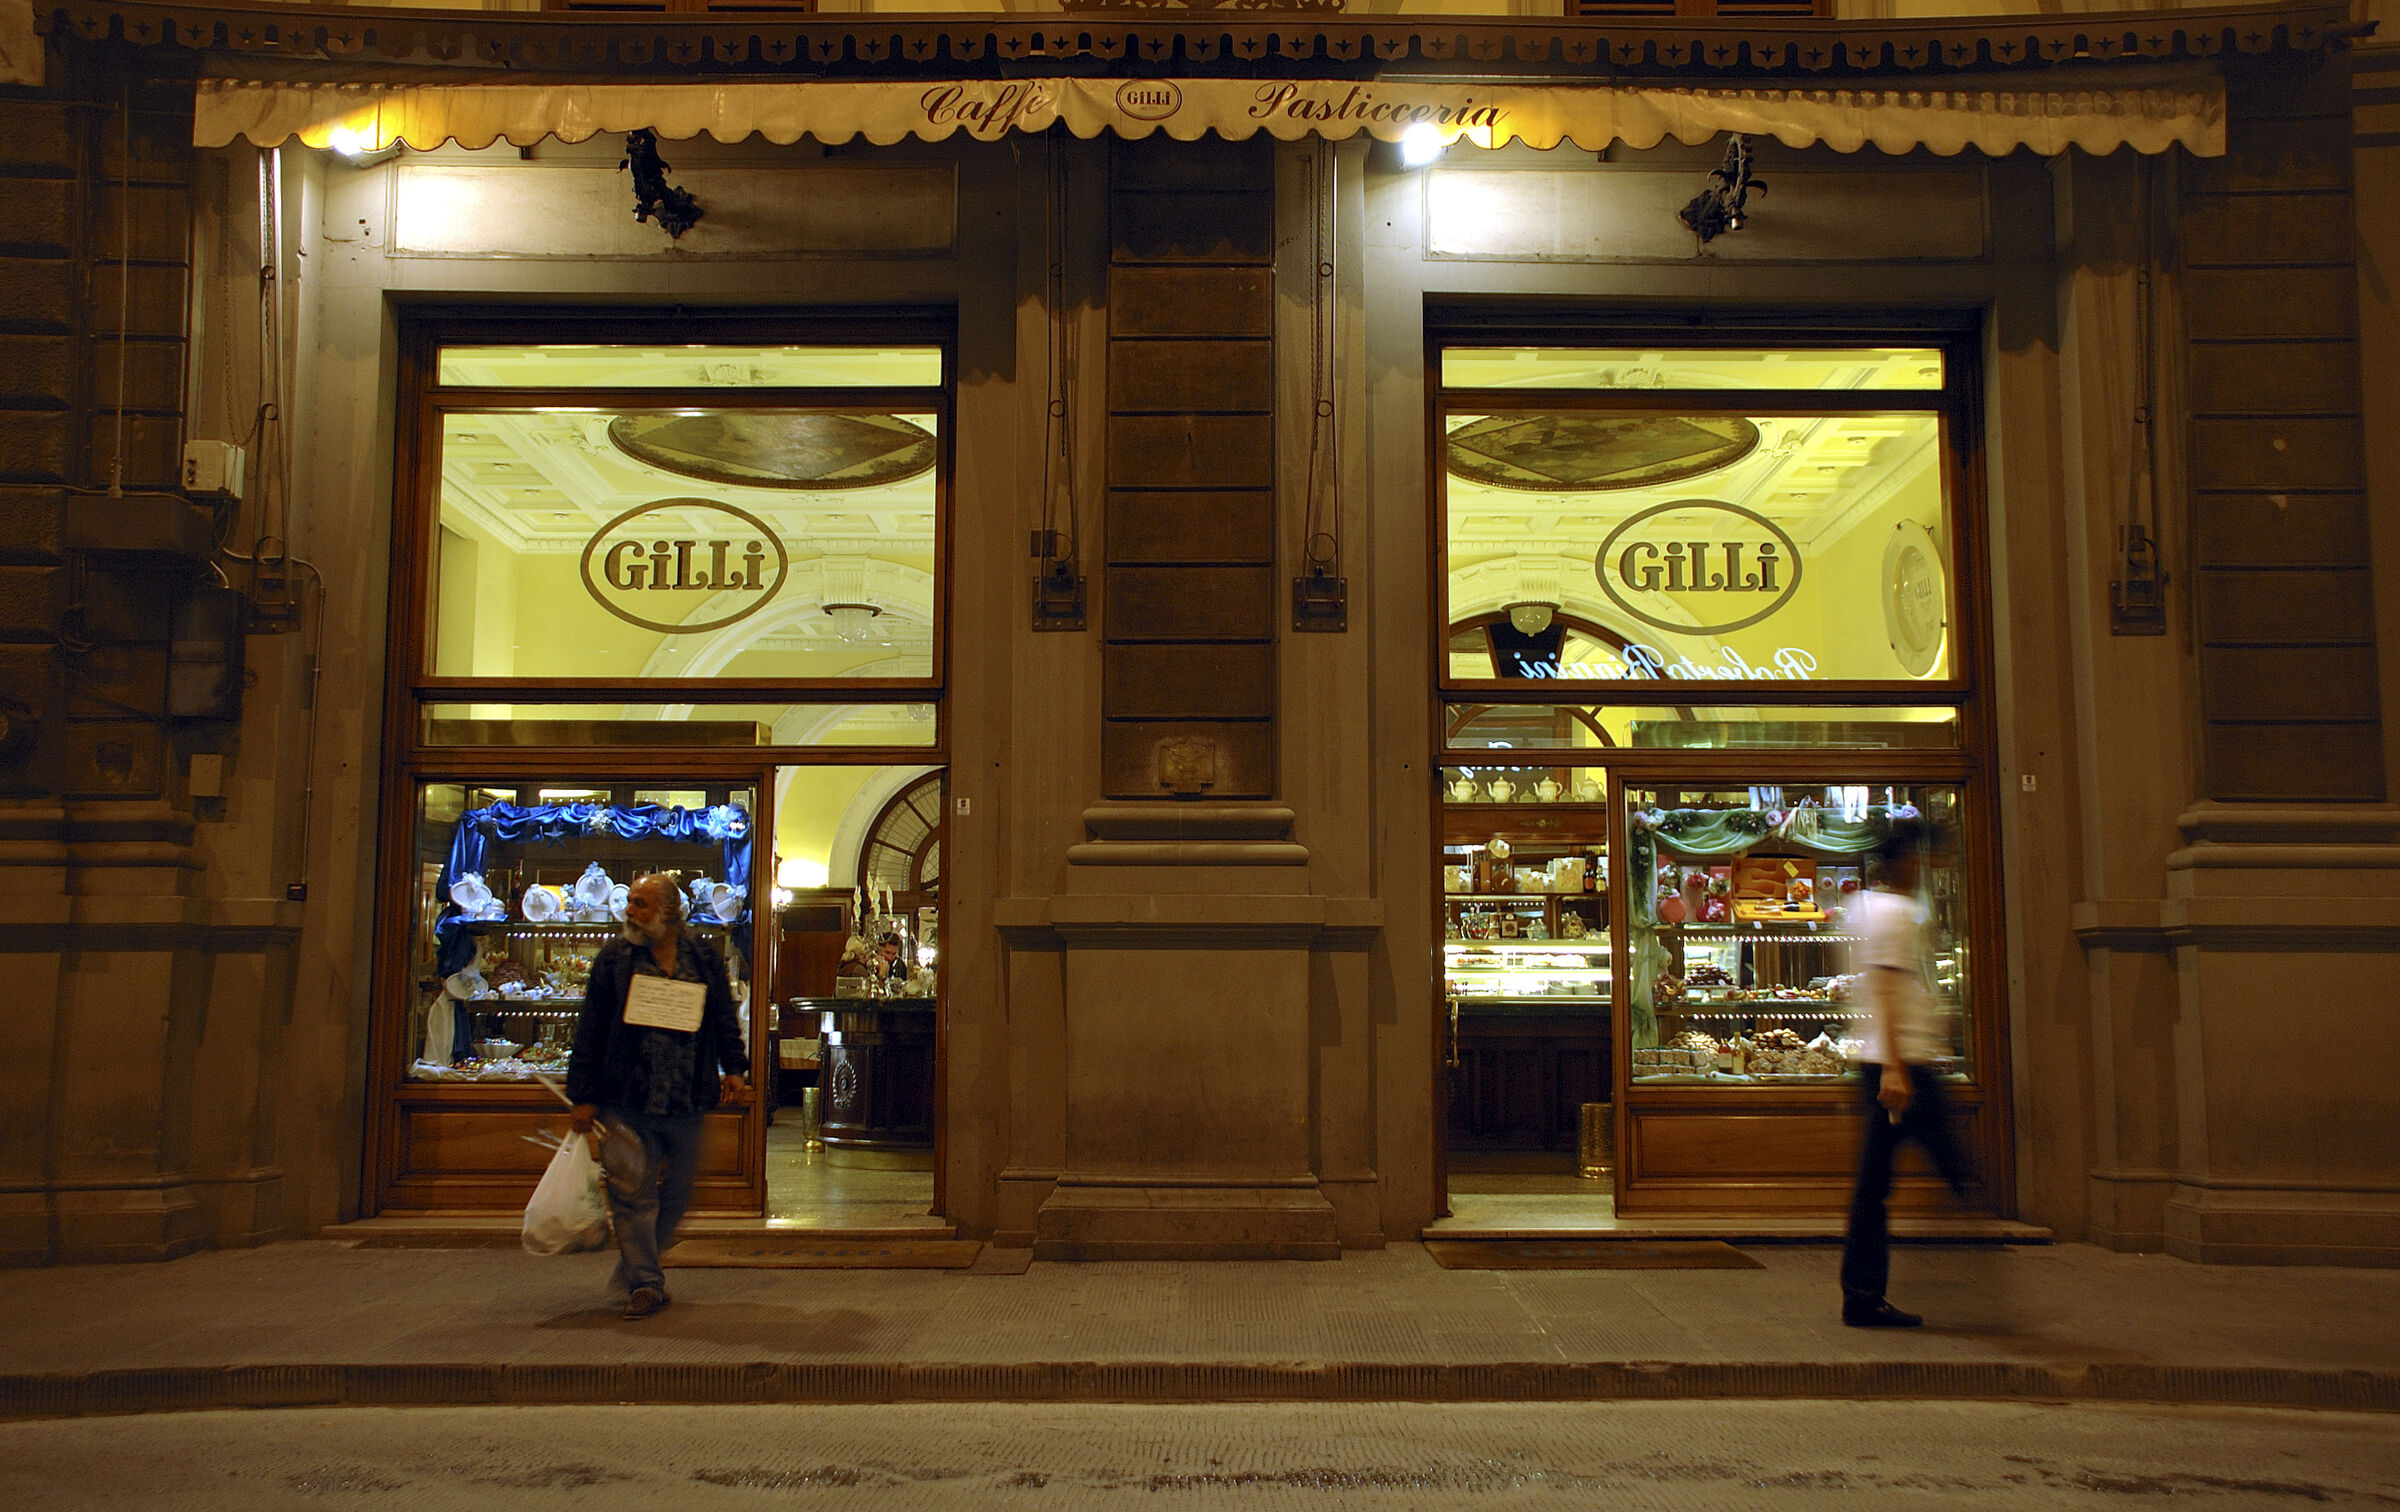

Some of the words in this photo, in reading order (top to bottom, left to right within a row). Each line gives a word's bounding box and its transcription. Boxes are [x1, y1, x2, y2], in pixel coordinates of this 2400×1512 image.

[920, 80, 1052, 133] Caffè
[1248, 81, 1510, 127] Pasticceria
[604, 539, 766, 591] GiLLi
[1618, 541, 1781, 593] GiLLi
